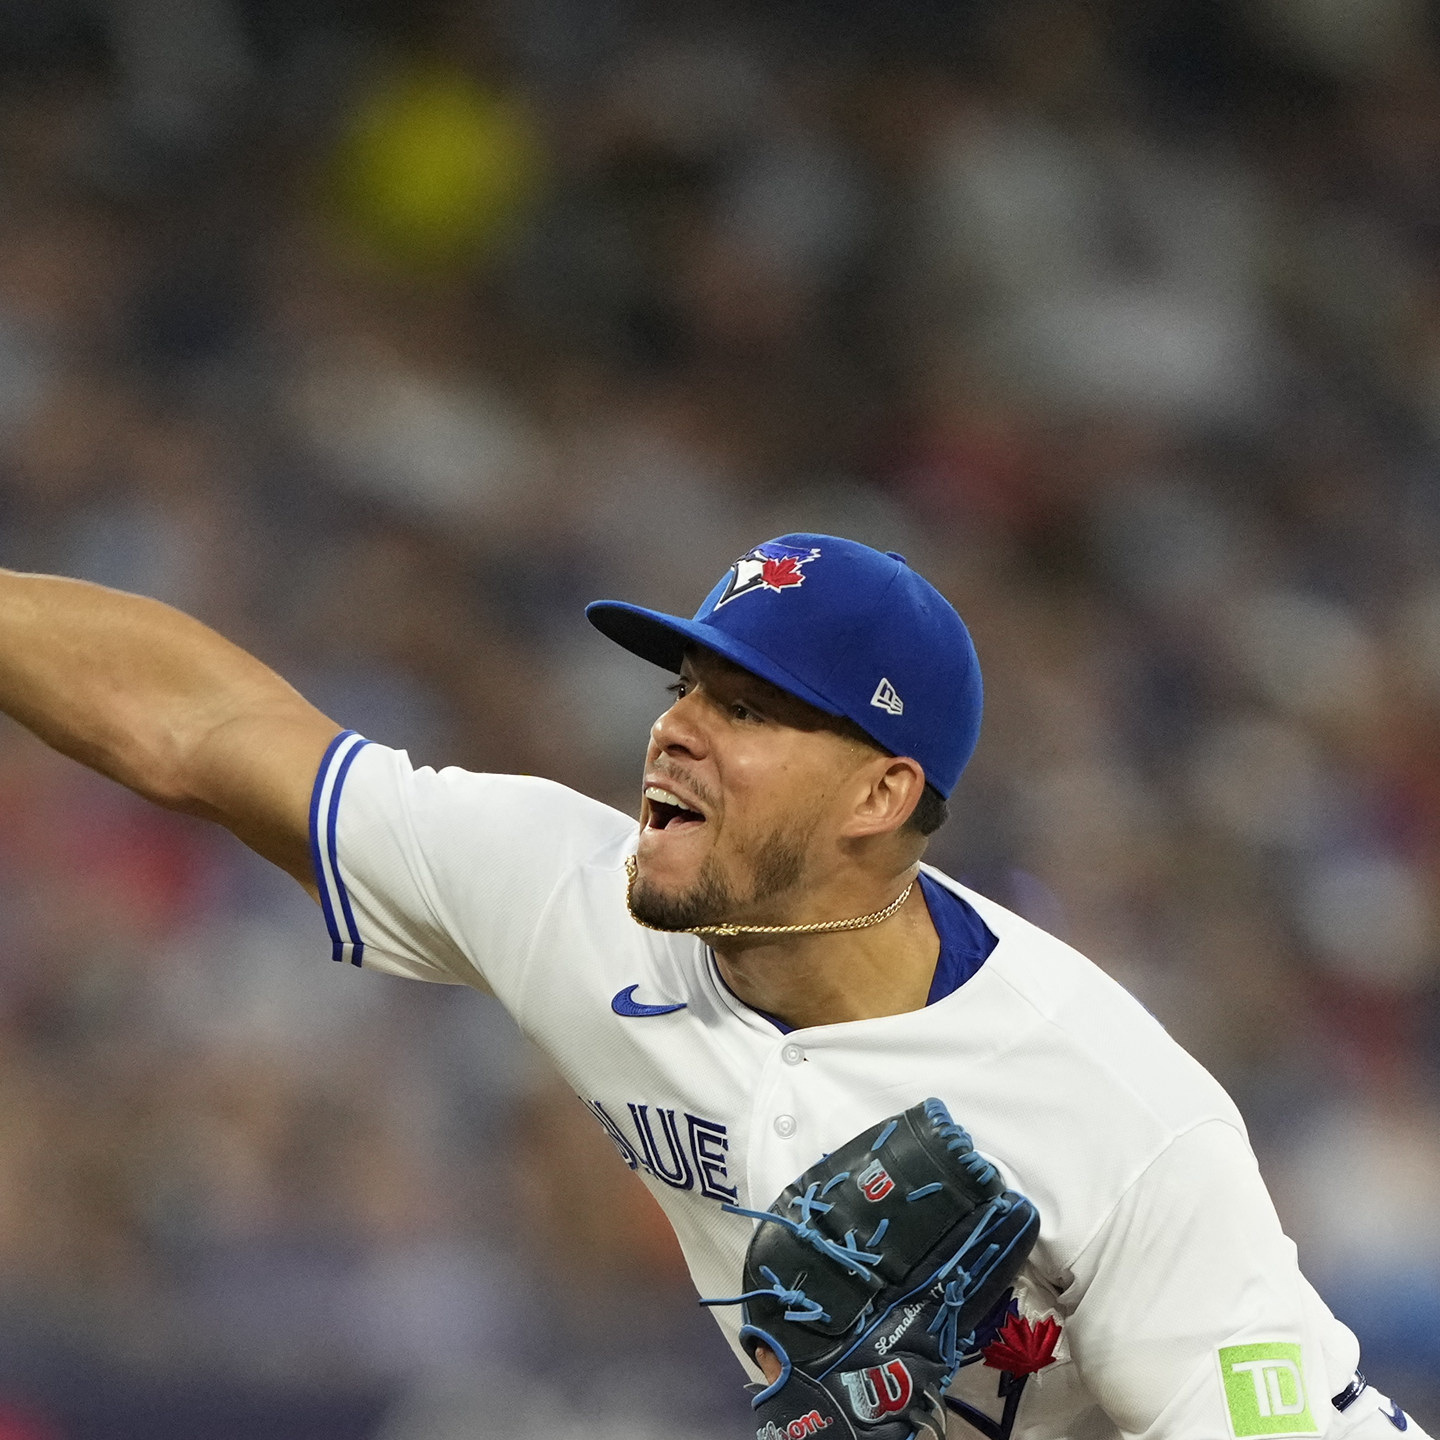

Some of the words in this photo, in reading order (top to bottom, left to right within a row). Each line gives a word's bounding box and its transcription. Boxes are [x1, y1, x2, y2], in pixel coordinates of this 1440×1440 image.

[874, 1299, 931, 1355] Lamakin
[840, 1357, 913, 1424] W
[1231, 1358, 1306, 1418] TD
